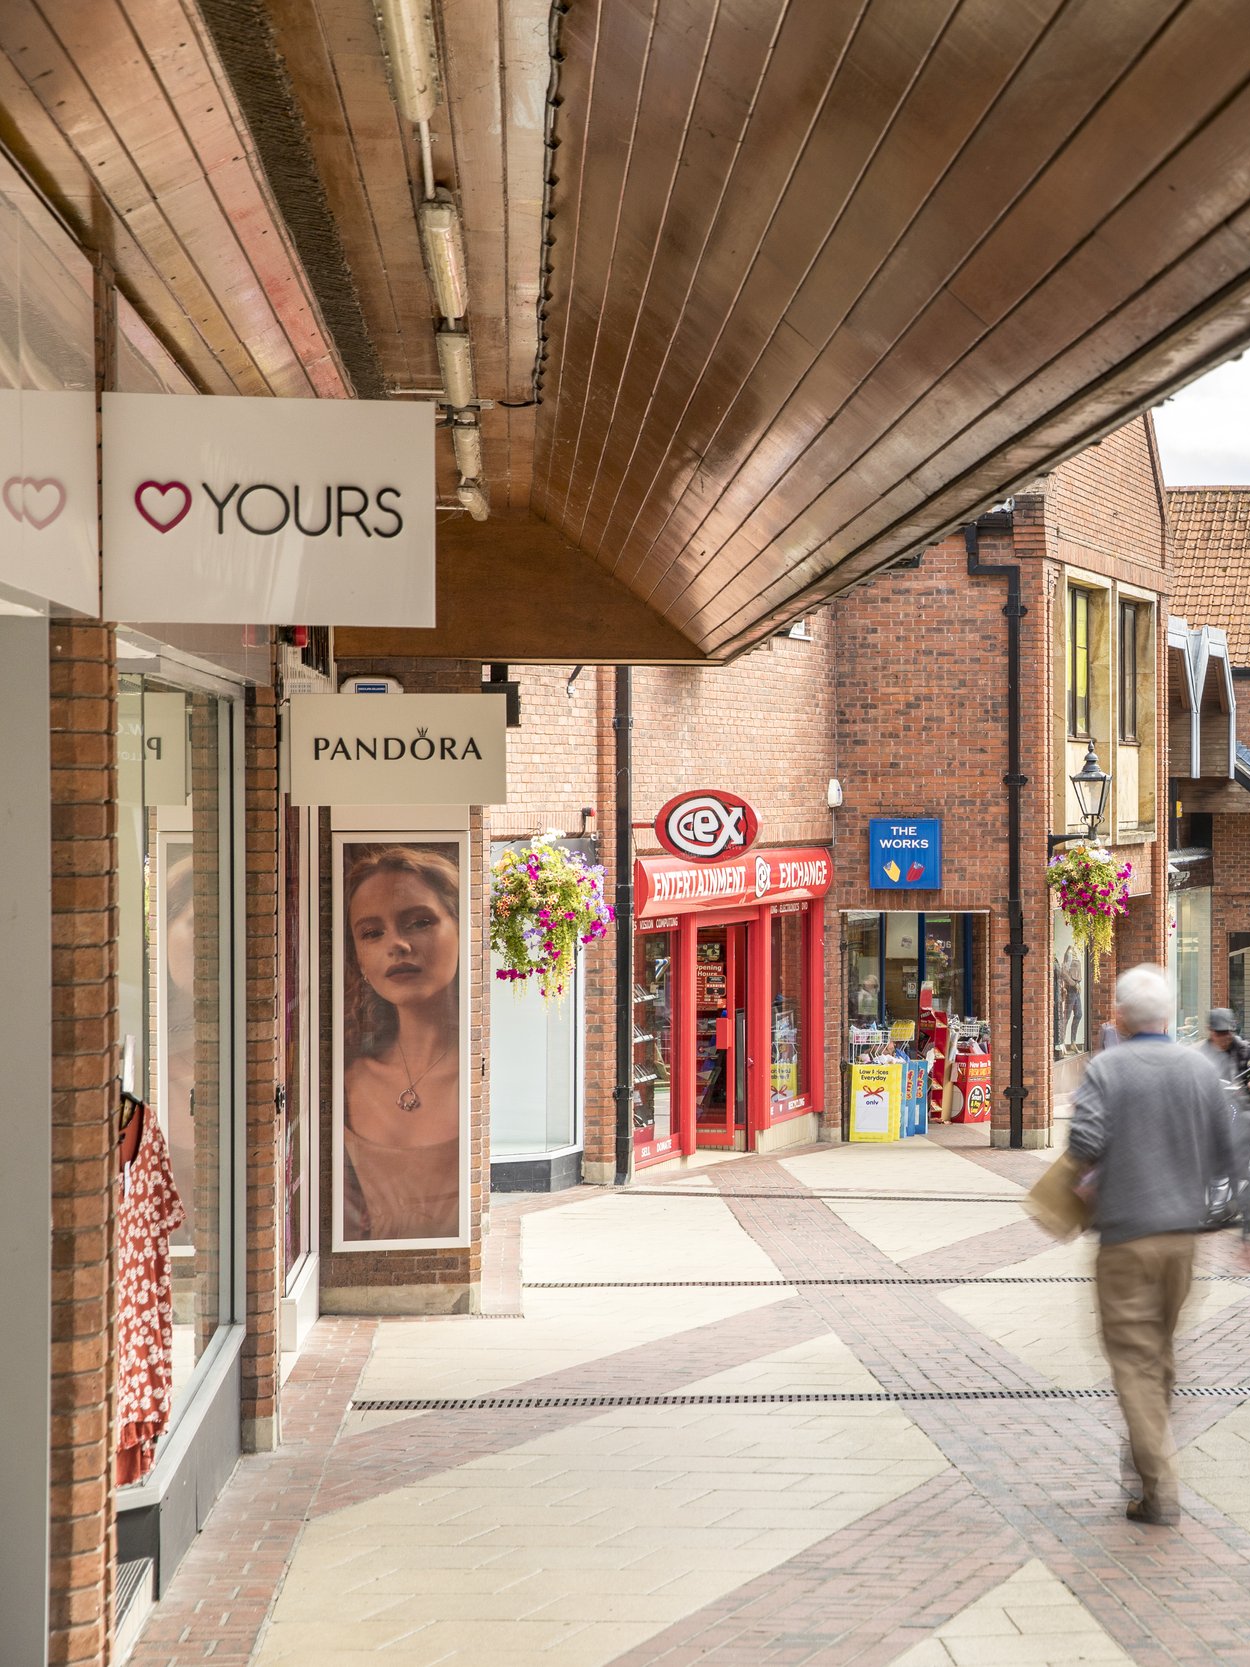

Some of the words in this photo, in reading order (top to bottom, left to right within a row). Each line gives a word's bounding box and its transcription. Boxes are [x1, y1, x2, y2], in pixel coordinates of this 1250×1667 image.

[201, 482, 403, 539] YOURS
[314, 735, 482, 761] PANDORA
[890, 826, 918, 836] THE
[879, 839, 930, 849] WORKS
[653, 866, 747, 902] ENTERTAINMENT
[779, 861, 828, 889] EXCHANGE
[861, 1074, 887, 1082] Everyday
